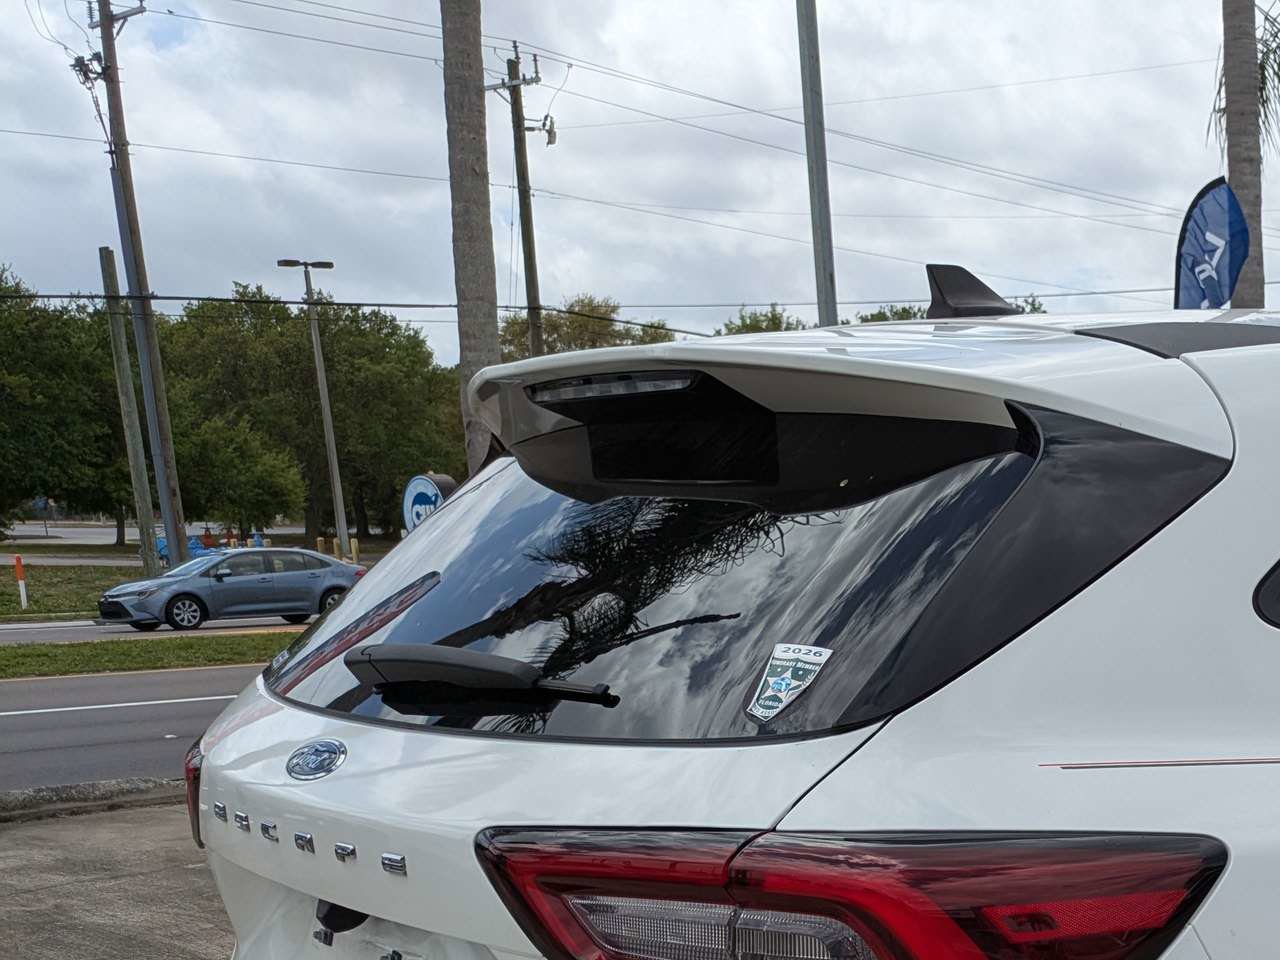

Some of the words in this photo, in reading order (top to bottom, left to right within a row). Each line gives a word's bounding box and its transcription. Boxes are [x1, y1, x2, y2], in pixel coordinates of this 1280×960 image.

[781, 646, 824, 657] 2026
[293, 745, 335, 769] Ford
[213, 800, 408, 877] ESCAPE
